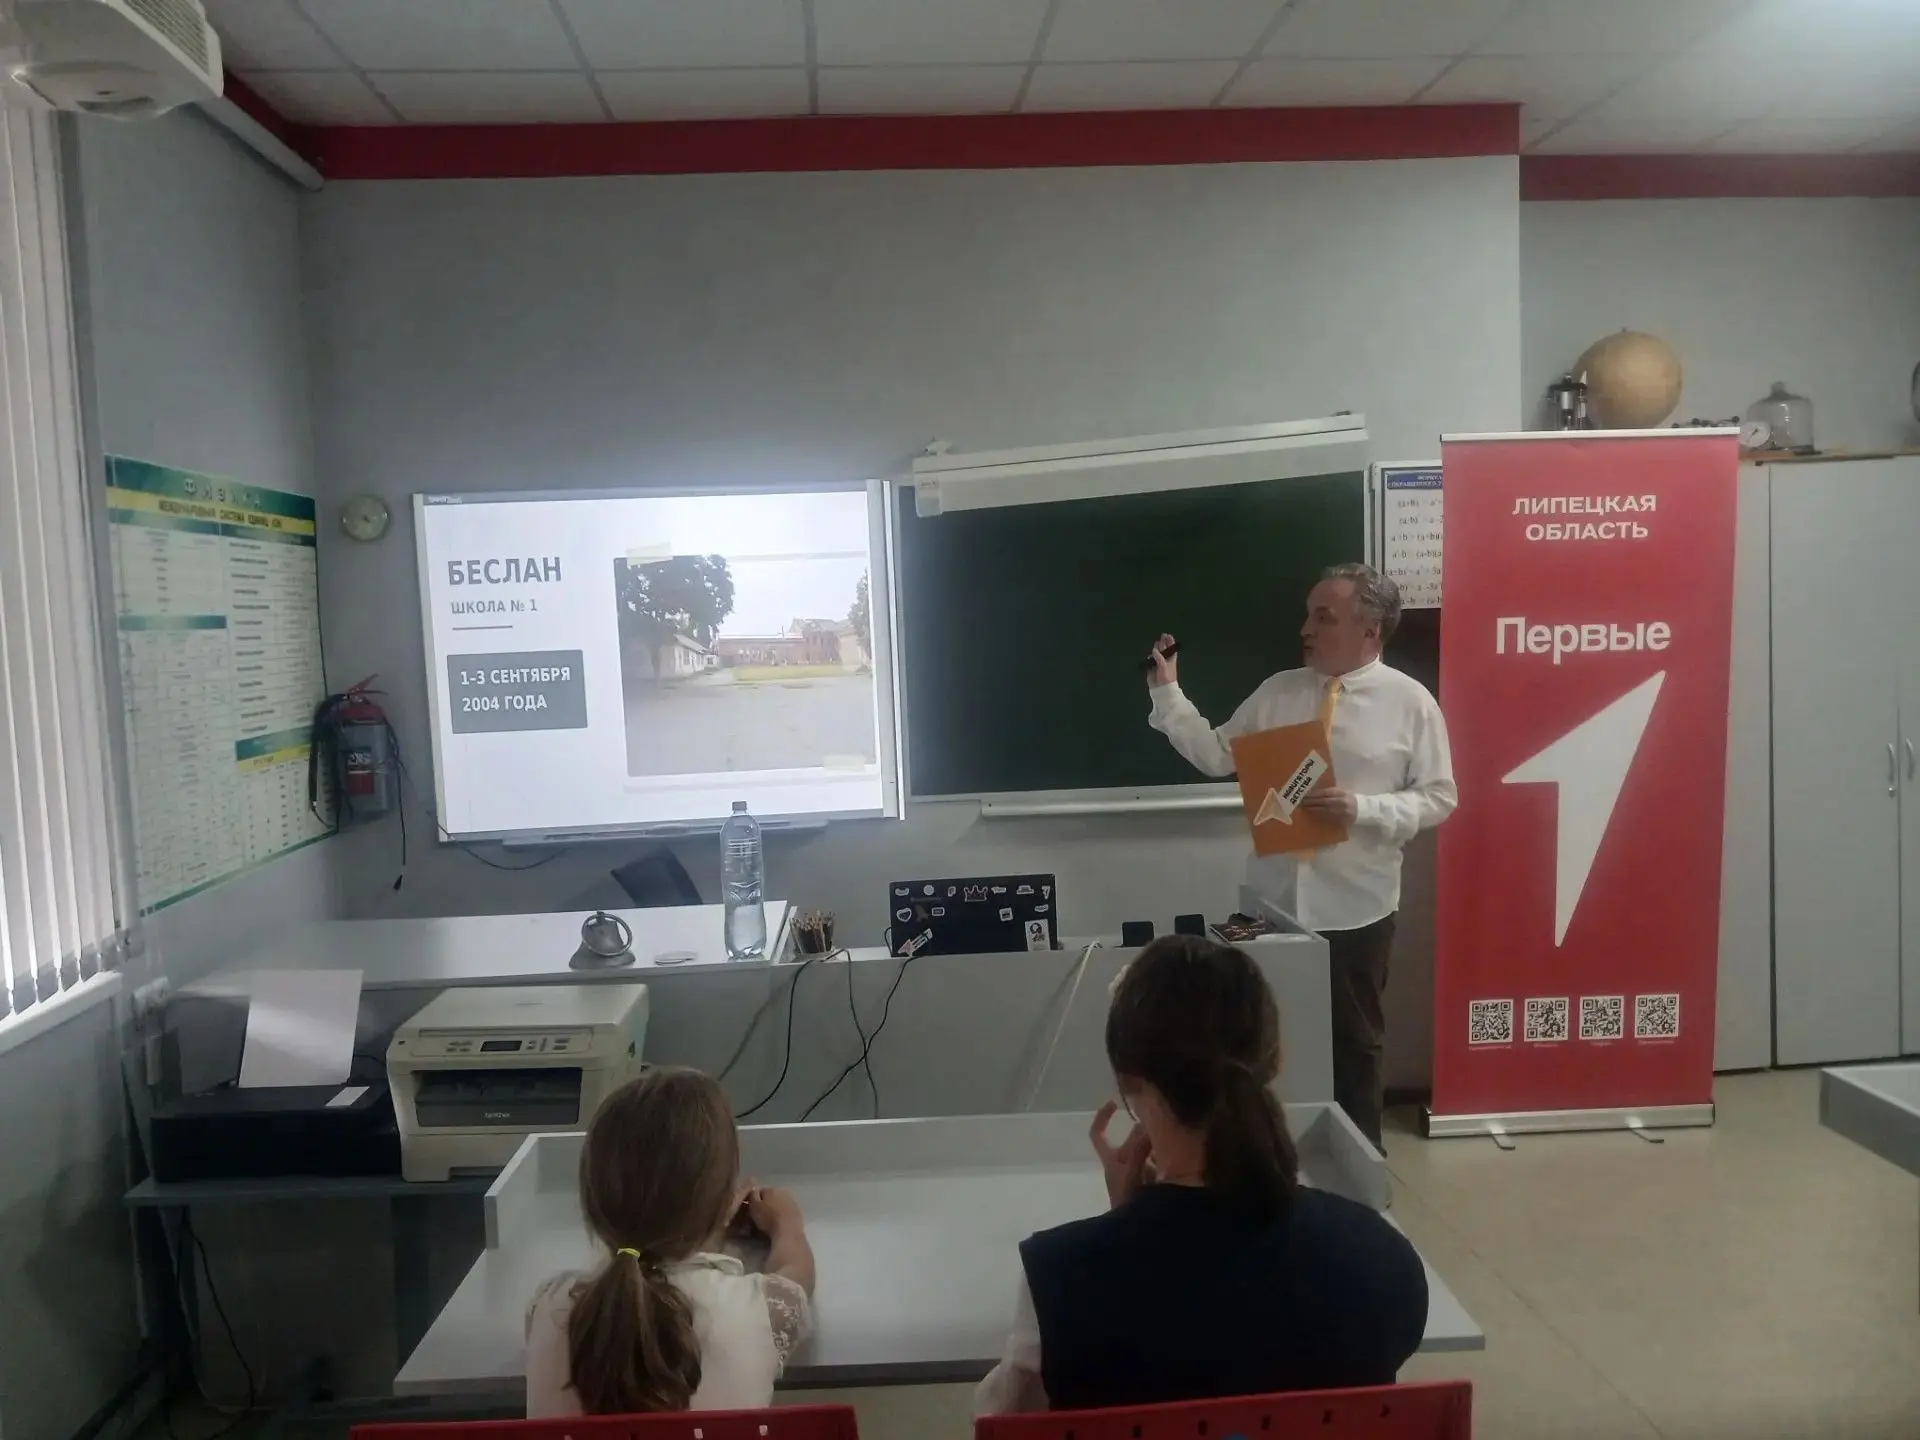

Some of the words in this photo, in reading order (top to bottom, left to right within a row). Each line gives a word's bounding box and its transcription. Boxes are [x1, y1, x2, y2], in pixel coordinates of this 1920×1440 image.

[1511, 494, 1657, 516] ЛИПЕЦКАЯ
[1524, 521, 1649, 541] ОБЛАСТЬ
[447, 556, 562, 586] БЕСЛАН
[451, 600, 506, 615] ШКОЛА
[510, 600, 525, 613] №
[530, 599, 538, 612] 1
[1495, 616, 1672, 665] Первые
[461, 671, 485, 686] 1-3
[490, 667, 571, 685] СЕНТЯБРЯ
[461, 697, 500, 712] 2004
[504, 694, 548, 712] ГОДА
